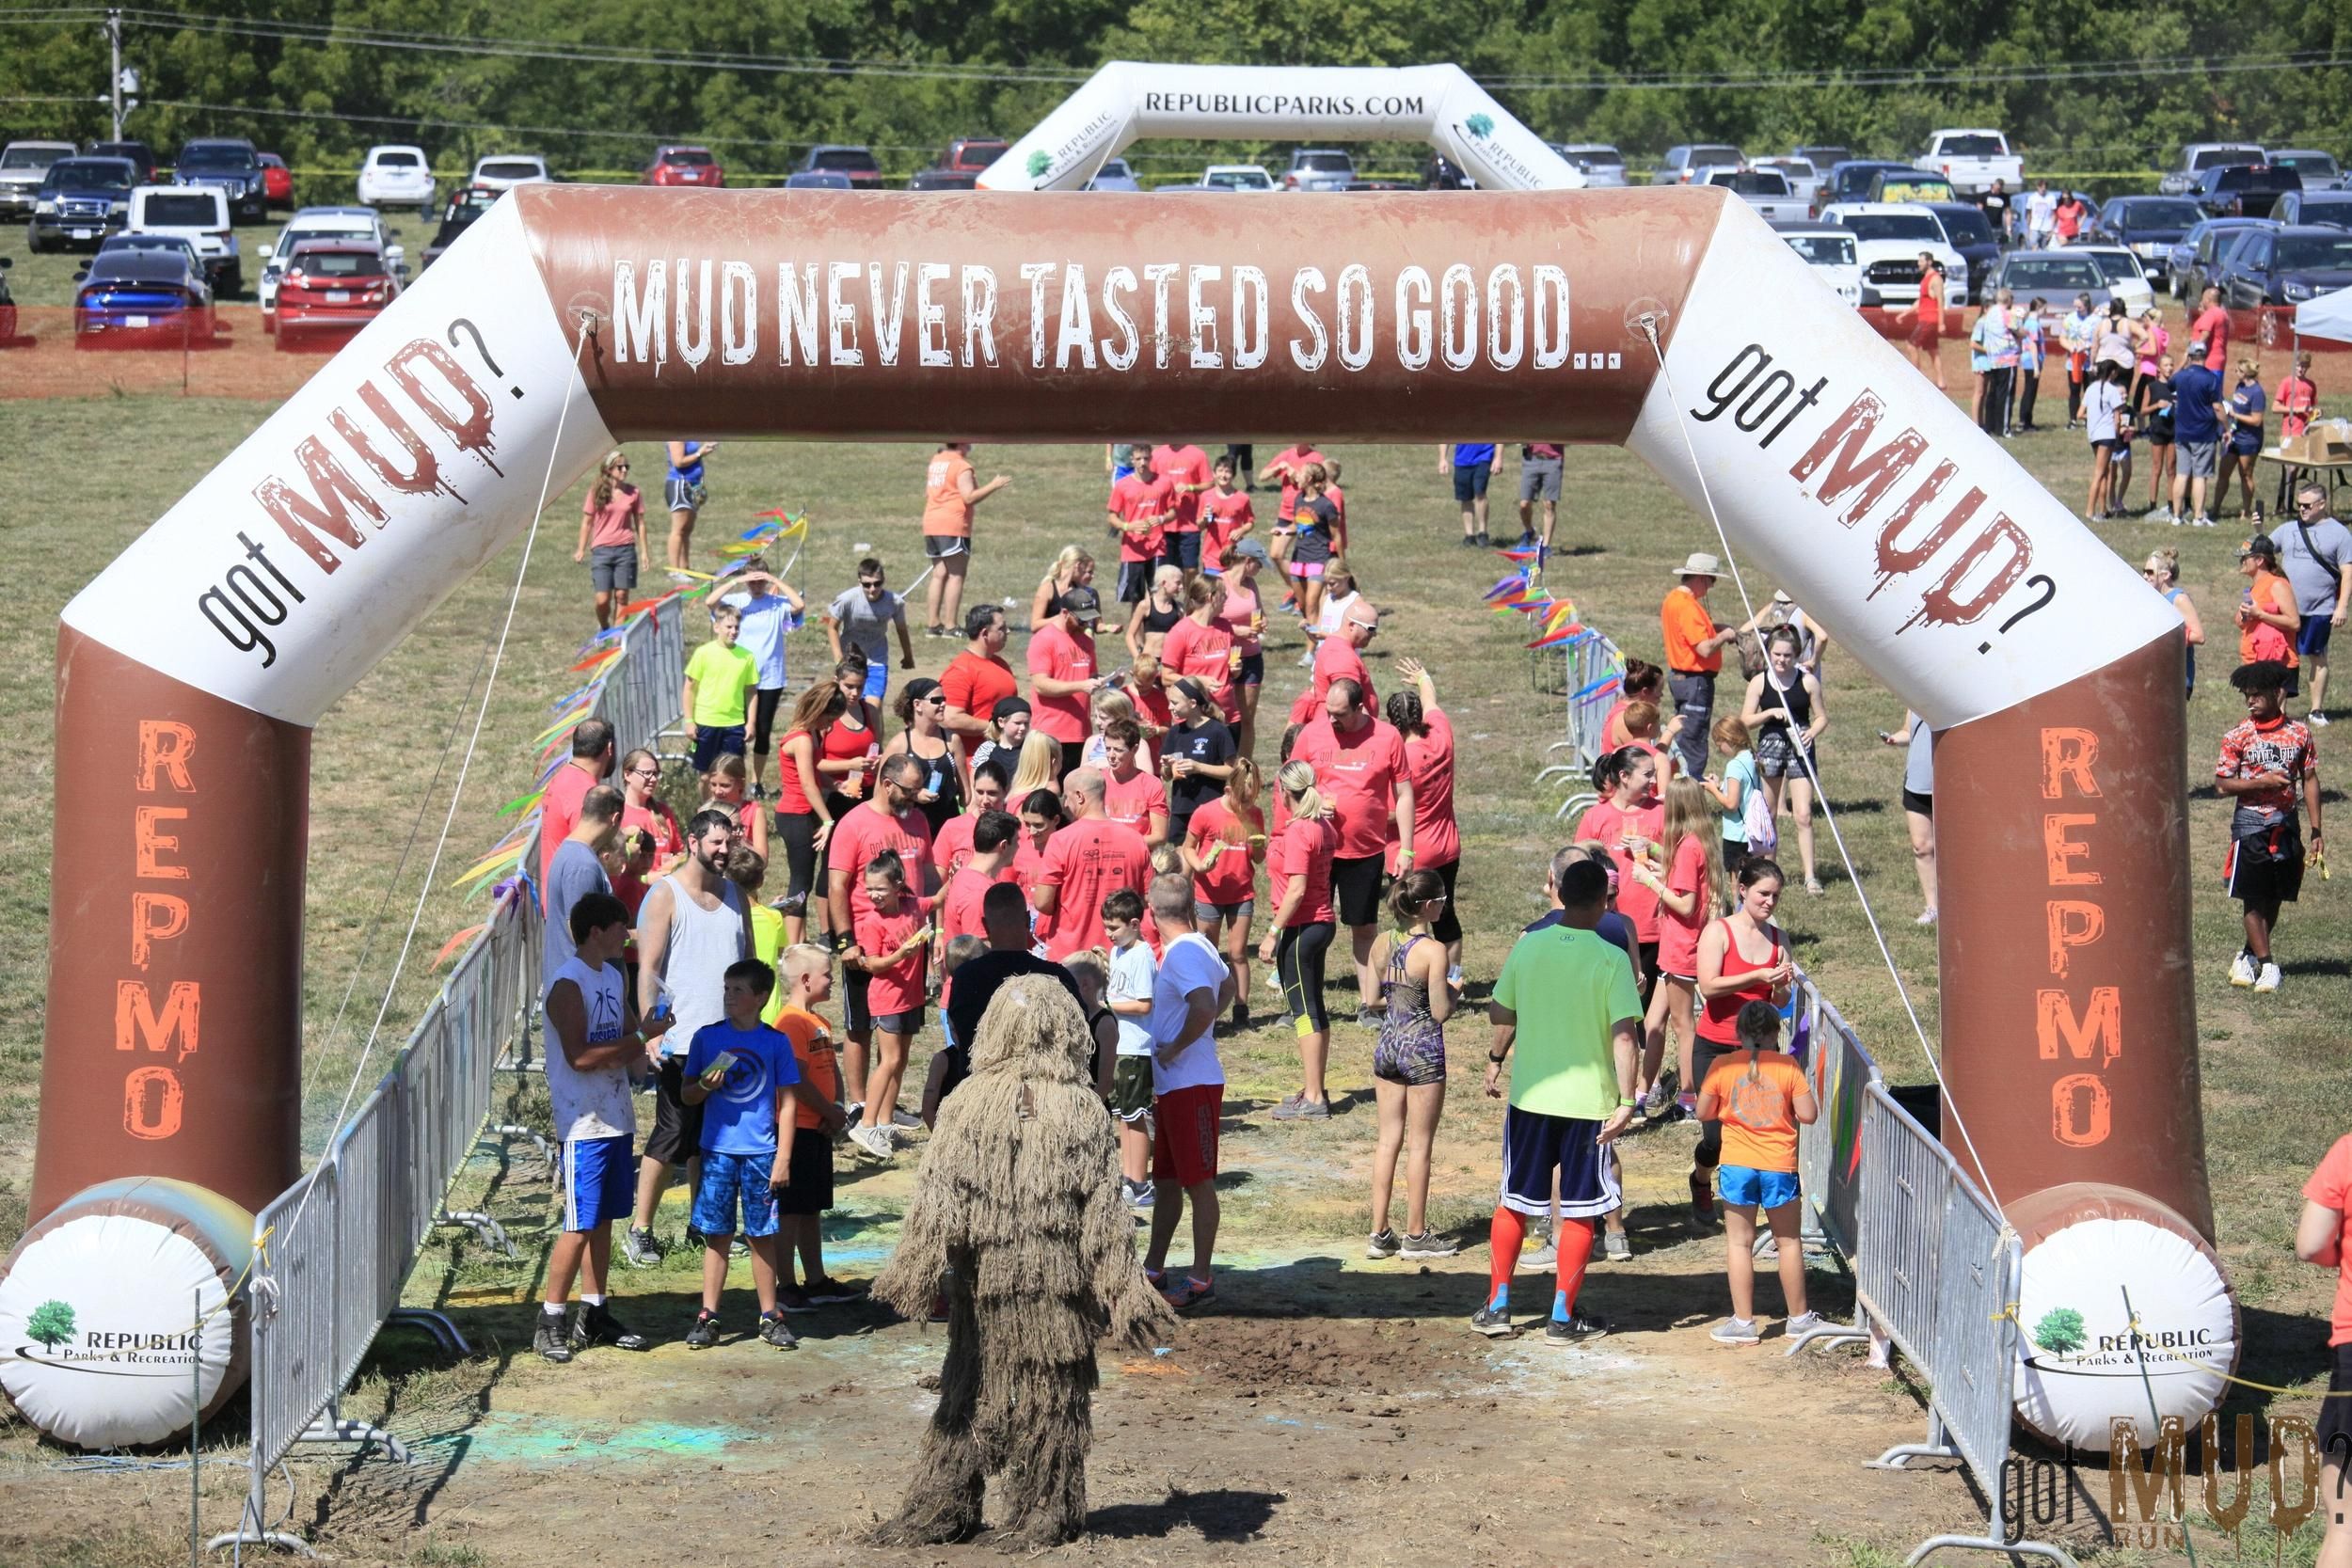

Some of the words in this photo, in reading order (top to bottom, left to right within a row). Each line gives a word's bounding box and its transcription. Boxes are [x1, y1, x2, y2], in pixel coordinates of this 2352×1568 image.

[1145, 92, 1423, 116] REPUBLICPARKS.COM
[1057, 111, 1112, 159] REPUBLIC
[1489, 142, 1544, 189] REPUBLIC
[613, 259, 757, 372] MUD
[779, 261, 999, 368] NEVER
[1021, 261, 1268, 372] TASTED
[1290, 262, 1375, 372] SO
[1395, 263, 1621, 372] GOOD...
[251, 317, 525, 575] MUD?
[1690, 342, 1829, 450] got
[1788, 387, 2057, 656] MUD?
[199, 531, 306, 669] got
[116, 720, 200, 1141] REPMO
[2036, 727, 2122, 1148] REPMO
[87, 1331, 203, 1351] REPUBLIC
[110, 1352, 121, 1363] &
[2099, 1327, 2212, 1352] REPUBLIC
[2123, 1353, 2135, 1364] &
